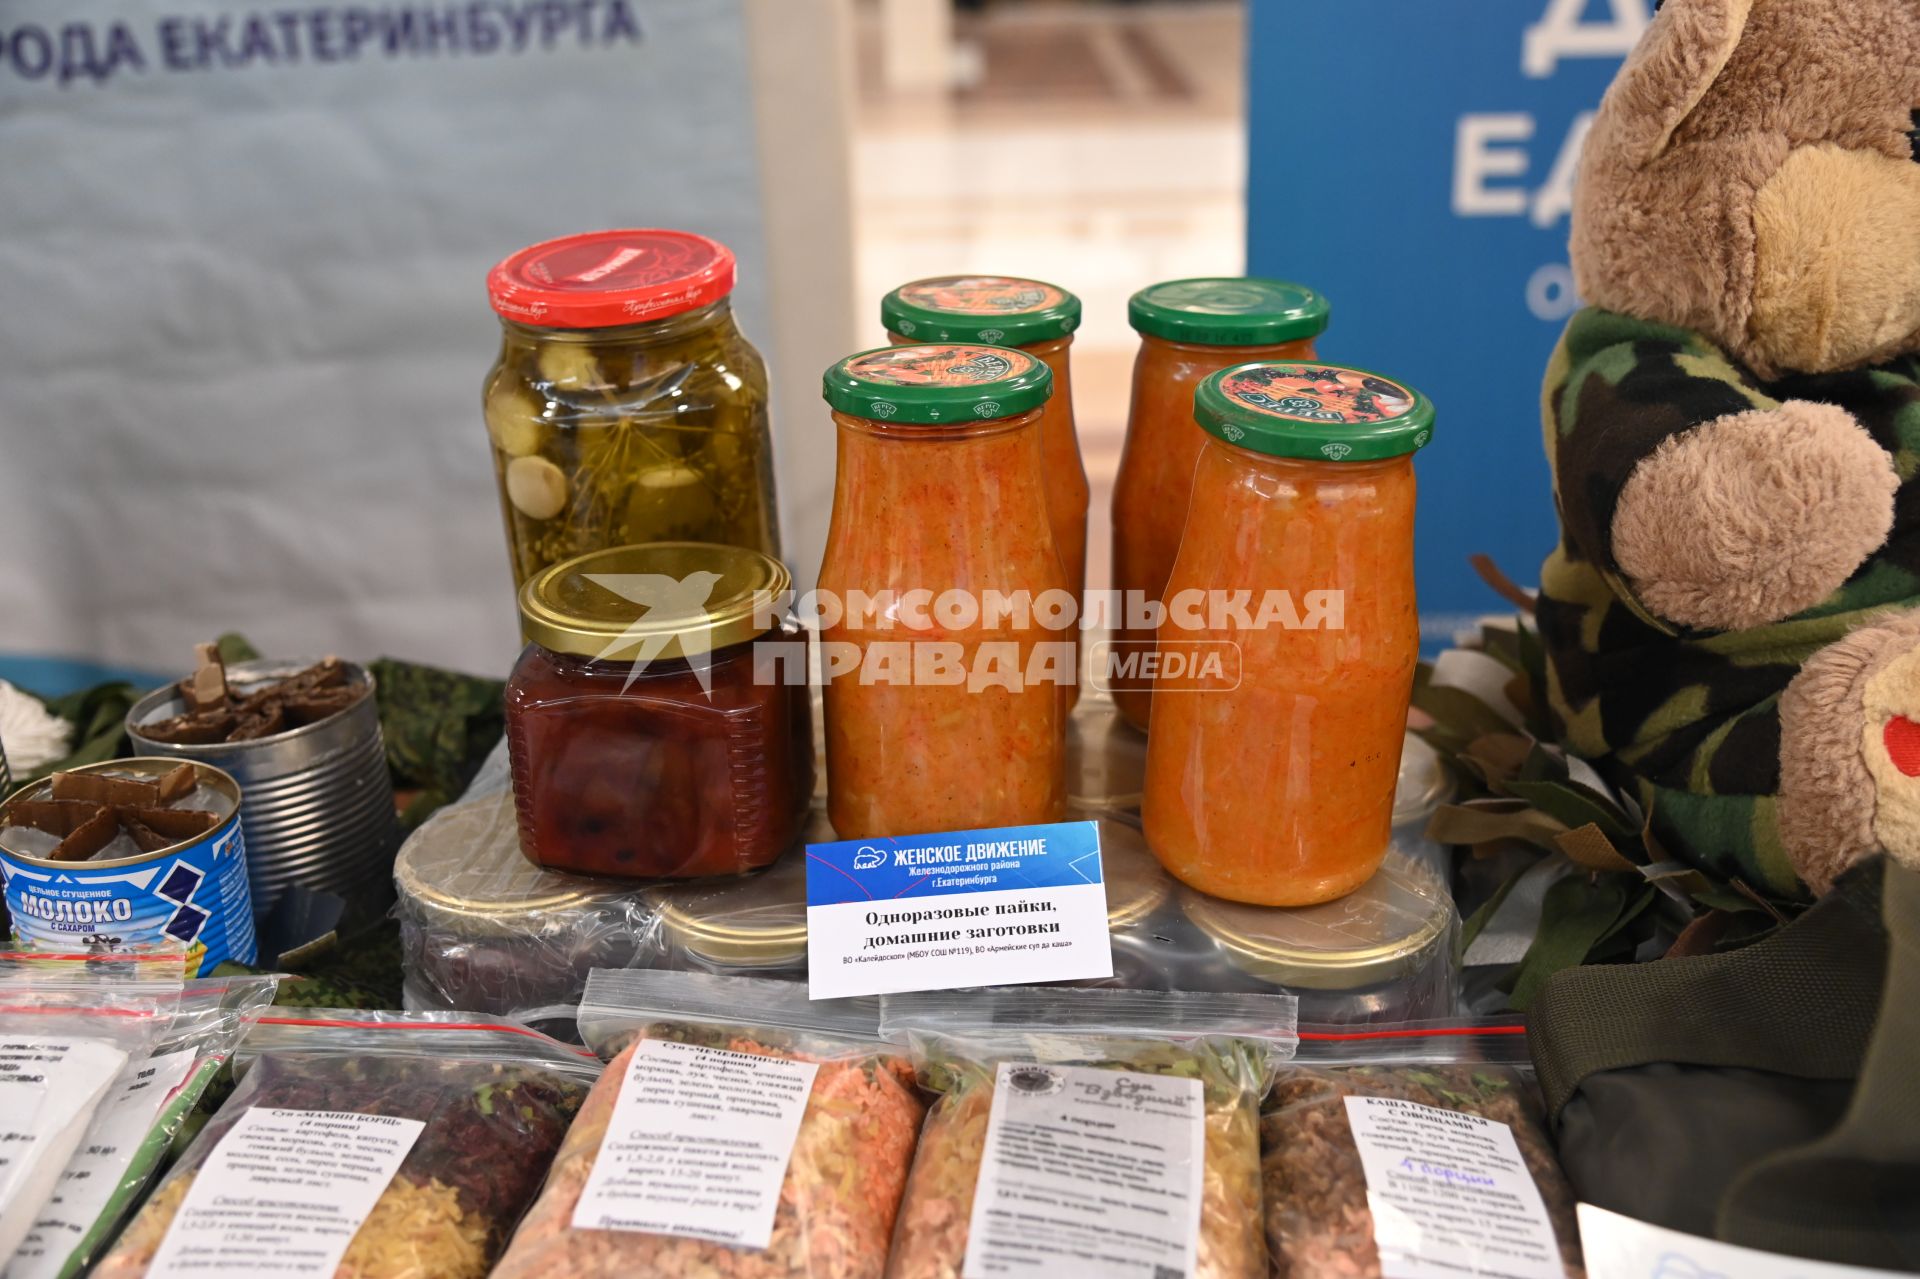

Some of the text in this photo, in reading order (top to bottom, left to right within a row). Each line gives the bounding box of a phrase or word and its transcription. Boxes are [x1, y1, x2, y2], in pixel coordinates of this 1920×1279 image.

[157, 0, 643, 72] ЕКАТЕРИНБУРГА
[894, 839, 1048, 866] ЖЕНСКОЕ ДВИЖЕНИЕ
[908, 860, 1020, 877] Железнодорожного района
[29, 885, 112, 899] ЦЕЛЬНОЕ СГУЩЕННОЕ
[932, 874, 998, 888] г.Екатеринбурга
[21, 891, 132, 924] МОЛОКО
[865, 899, 1057, 926] Одноразовые пайки,
[58, 924, 95, 932] САХАРОМ
[863, 921, 1061, 950] домашние заготовки
[843, 956, 853, 965] ВО
[855, 952, 905, 964] «Калейдоскоп»
[907, 948, 929, 961] (МБОУ
[931, 949, 947, 957] СОШ
[948, 946, 974, 957] №119),
[975, 945, 985, 953] ВО
[987, 942, 1028, 952] «Армейские
[1028, 943, 1040, 952] суп
[1041, 942, 1050, 950] да
[1367, 1098, 1407, 1109] КАША
